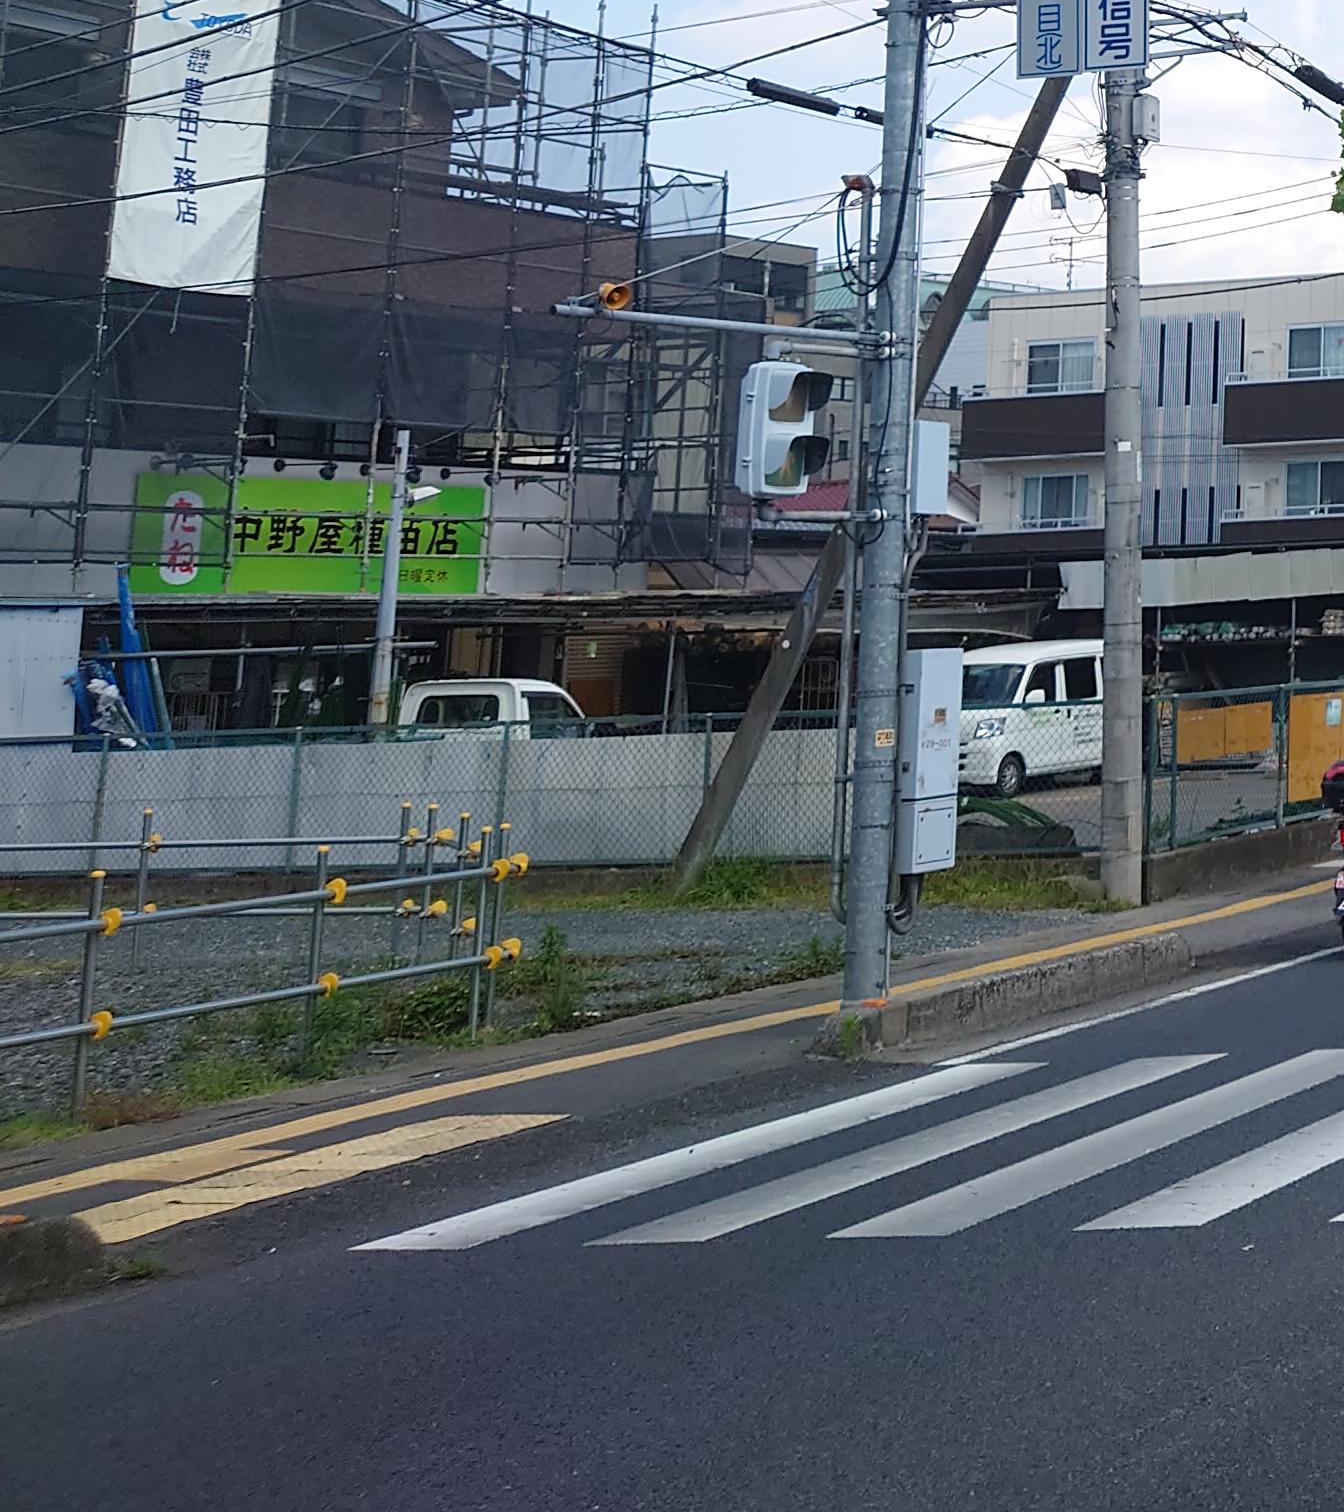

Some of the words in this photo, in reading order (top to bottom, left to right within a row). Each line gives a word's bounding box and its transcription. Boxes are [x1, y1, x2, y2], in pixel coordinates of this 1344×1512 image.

[173, 78, 205, 226] 豊田工務店
